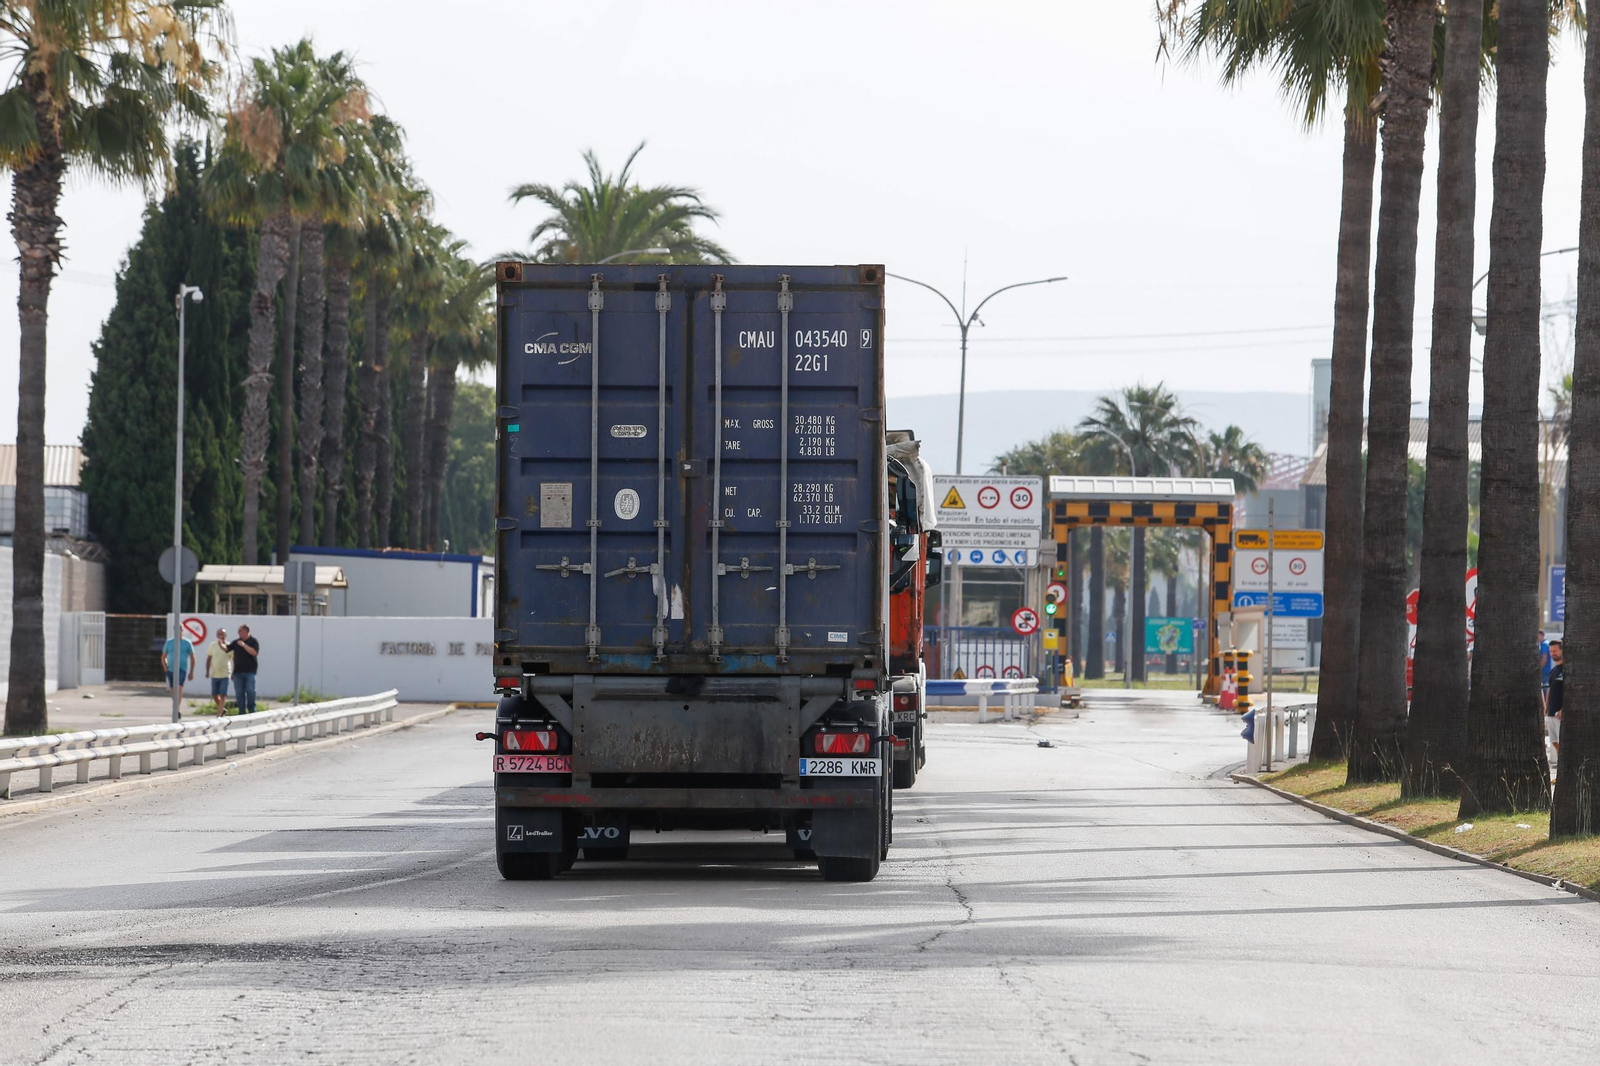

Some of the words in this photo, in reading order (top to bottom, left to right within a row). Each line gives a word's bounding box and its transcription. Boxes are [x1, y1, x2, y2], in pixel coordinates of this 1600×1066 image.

[739, 330, 775, 348] CMAU
[796, 330, 848, 348] 043540
[862, 330, 871, 348] 9
[524, 343, 557, 354] CMA
[560, 342, 592, 354] CGM
[795, 354, 828, 372] 22G1
[753, 420, 774, 428] GROSS
[795, 416, 822, 424] 30.480
[826, 416, 836, 424] KG
[795, 426, 822, 434] 67.200
[826, 426, 835, 434] LB
[725, 440, 740, 450] TARE
[800, 438, 822, 446] 2.190
[826, 438, 835, 446] KG
[799, 447, 822, 456] 4.830
[826, 447, 835, 456] LB
[725, 486, 737, 496] NET
[794, 484, 820, 492] 28.290
[824, 484, 834, 492] KG
[794, 493, 820, 502] 62.370
[824, 493, 834, 502] LB
[1014, 494, 1028, 502] 30
[724, 508, 736, 518] CU.
[748, 508, 762, 518] CAP.
[803, 505, 820, 514] 33.2
[824, 505, 840, 514] CU.M
[799, 514, 820, 524] 1.172
[824, 514, 842, 524] CU.FT
[448, 642, 465, 656] DE
[898, 712, 914, 720] KRC
[496, 758, 504, 770] R
[510, 758, 542, 770] 5724
[546, 758, 572, 770] BCN
[810, 760, 842, 774] 2286
[852, 760, 876, 774] KMR
